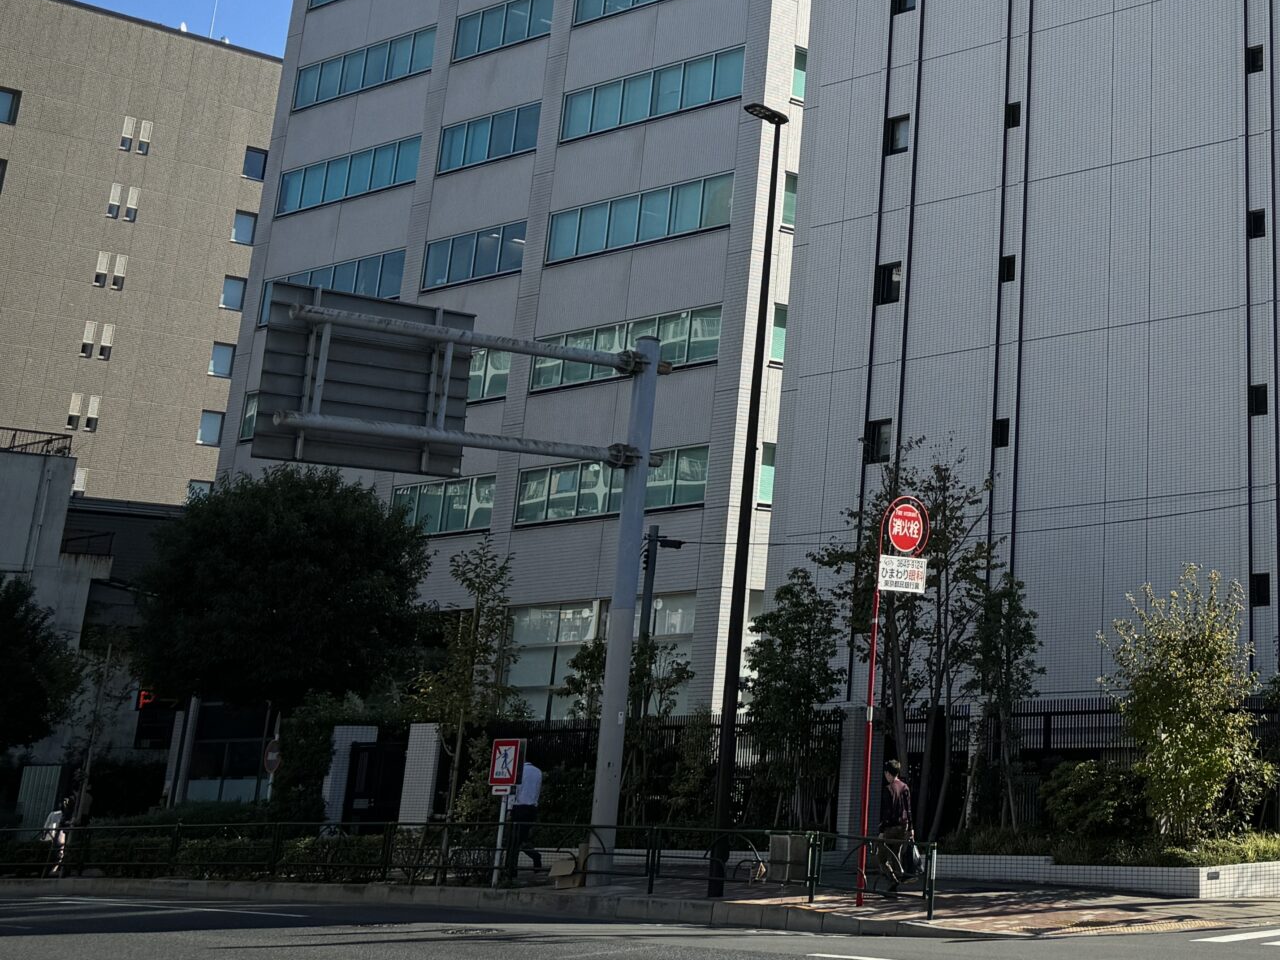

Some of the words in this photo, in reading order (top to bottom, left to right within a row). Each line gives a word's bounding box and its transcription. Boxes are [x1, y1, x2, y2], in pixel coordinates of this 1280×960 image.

[892, 518, 920, 538] 消火栓
[881, 567, 924, 582] ひまわり眼科
